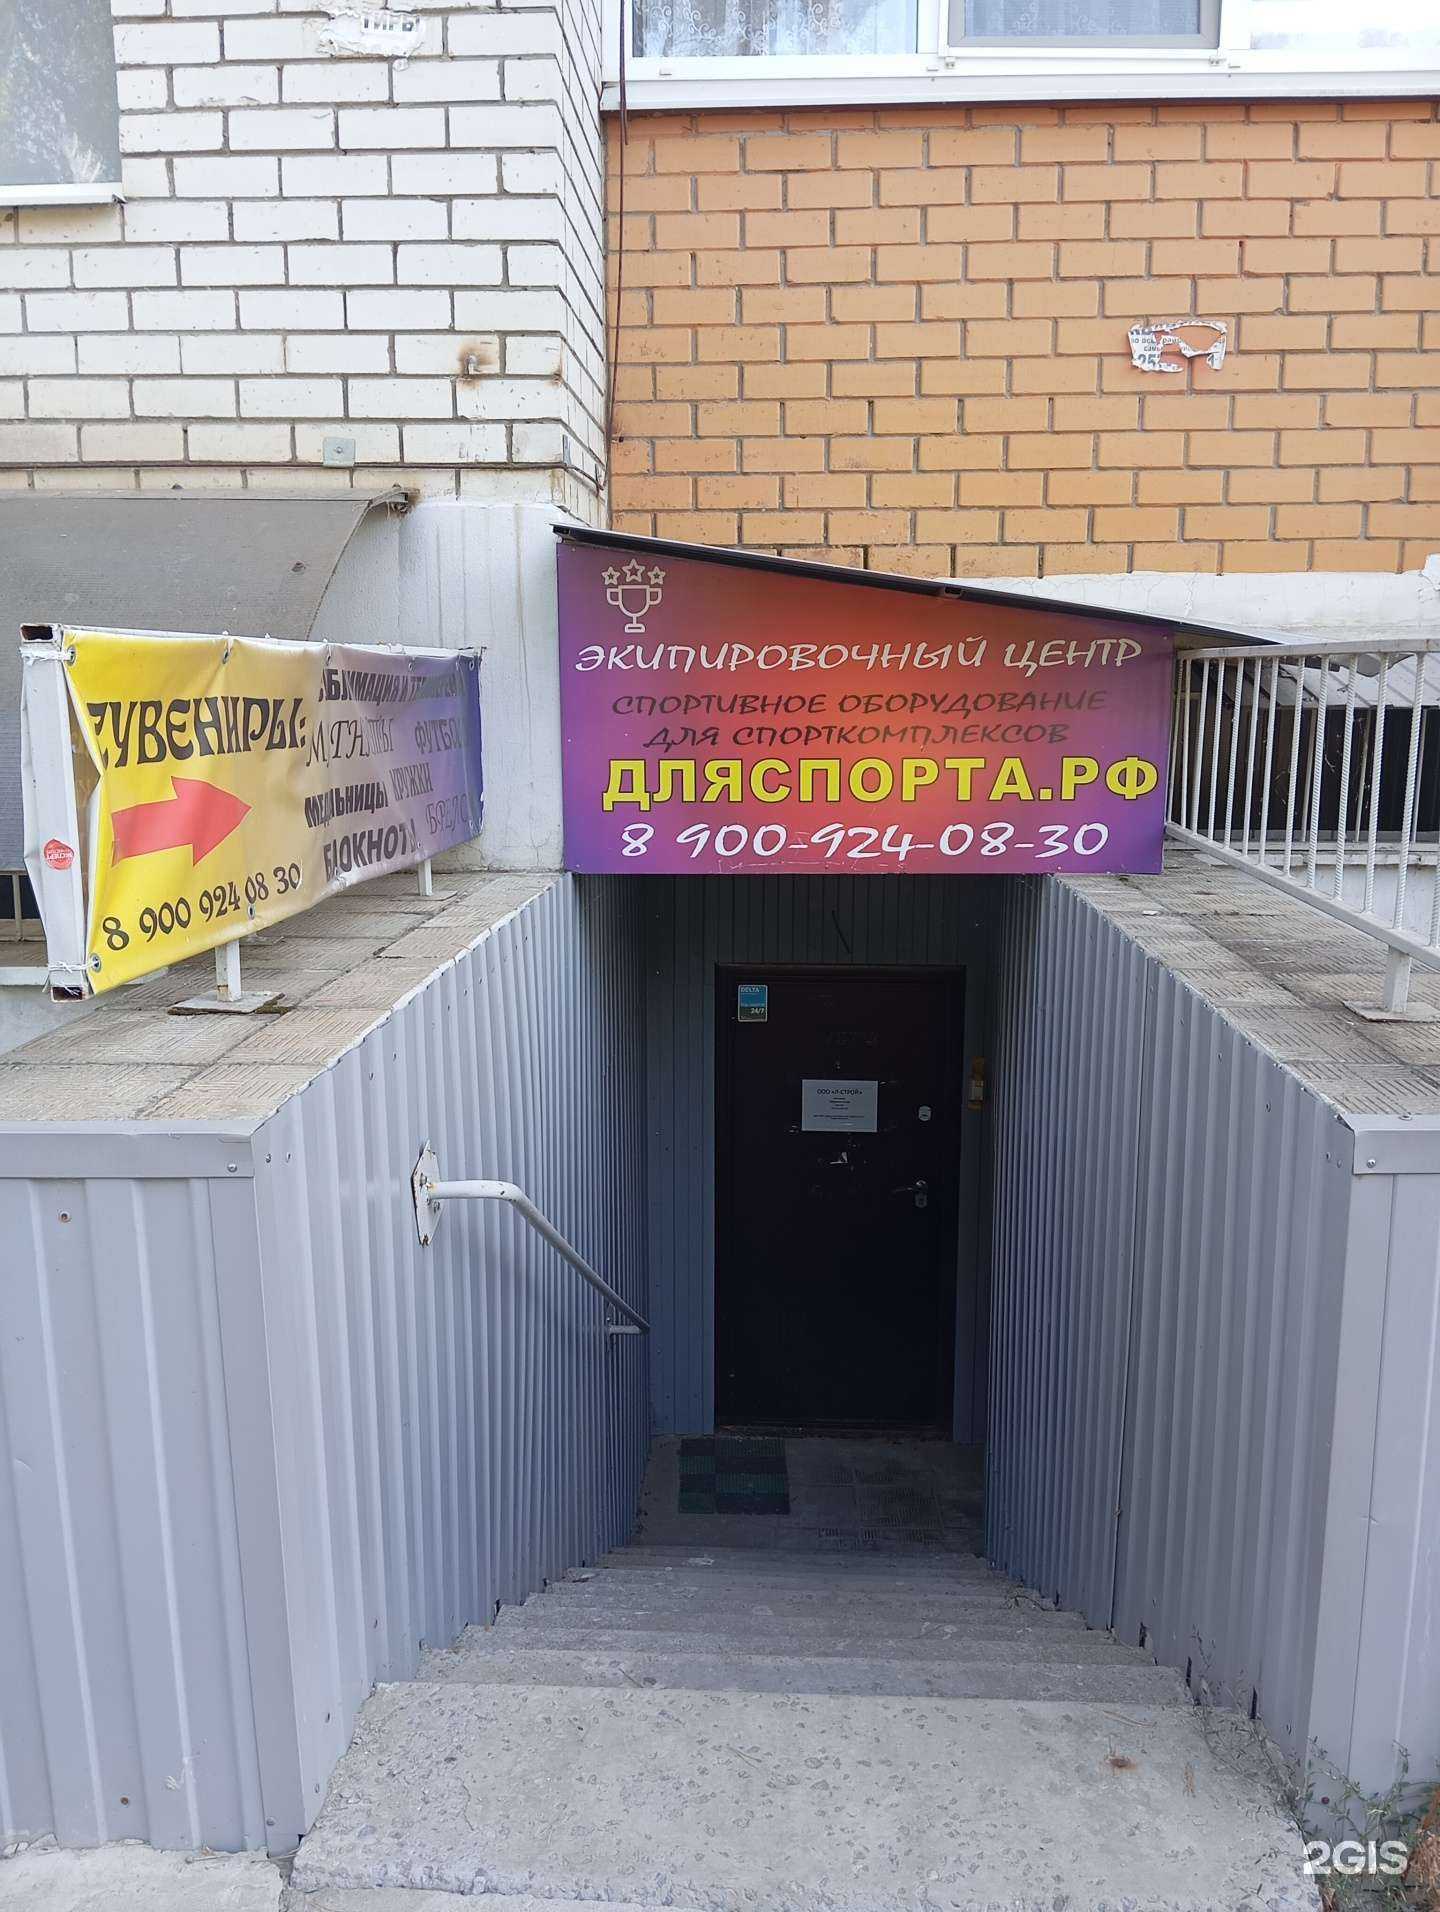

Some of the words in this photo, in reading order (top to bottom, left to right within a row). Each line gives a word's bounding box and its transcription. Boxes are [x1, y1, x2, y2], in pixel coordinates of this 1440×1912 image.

[575, 634, 985, 675] ЭКИПИРОВОЧНЫЙ
[1002, 637, 1144, 678] ЦЕНТР
[611, 692, 827, 716] СПОРТИВНОЕ
[838, 690, 1109, 719] ОБОРУДОВАНИЕ
[643, 725, 720, 749] ДЛЯ
[732, 723, 1072, 749] СПОРТКОМПЛЕКСОВ
[602, 755, 1158, 813] ДЛЯСПОРТА.РФ
[621, 822, 655, 859] 8
[676, 821, 1110, 862] 900-924-08-30
[102, 915, 130, 951] 8
[139, 896, 192, 942] 900
[199, 881, 241, 922] 924
[244, 872, 270, 905] 08
[273, 862, 303, 895] 30
